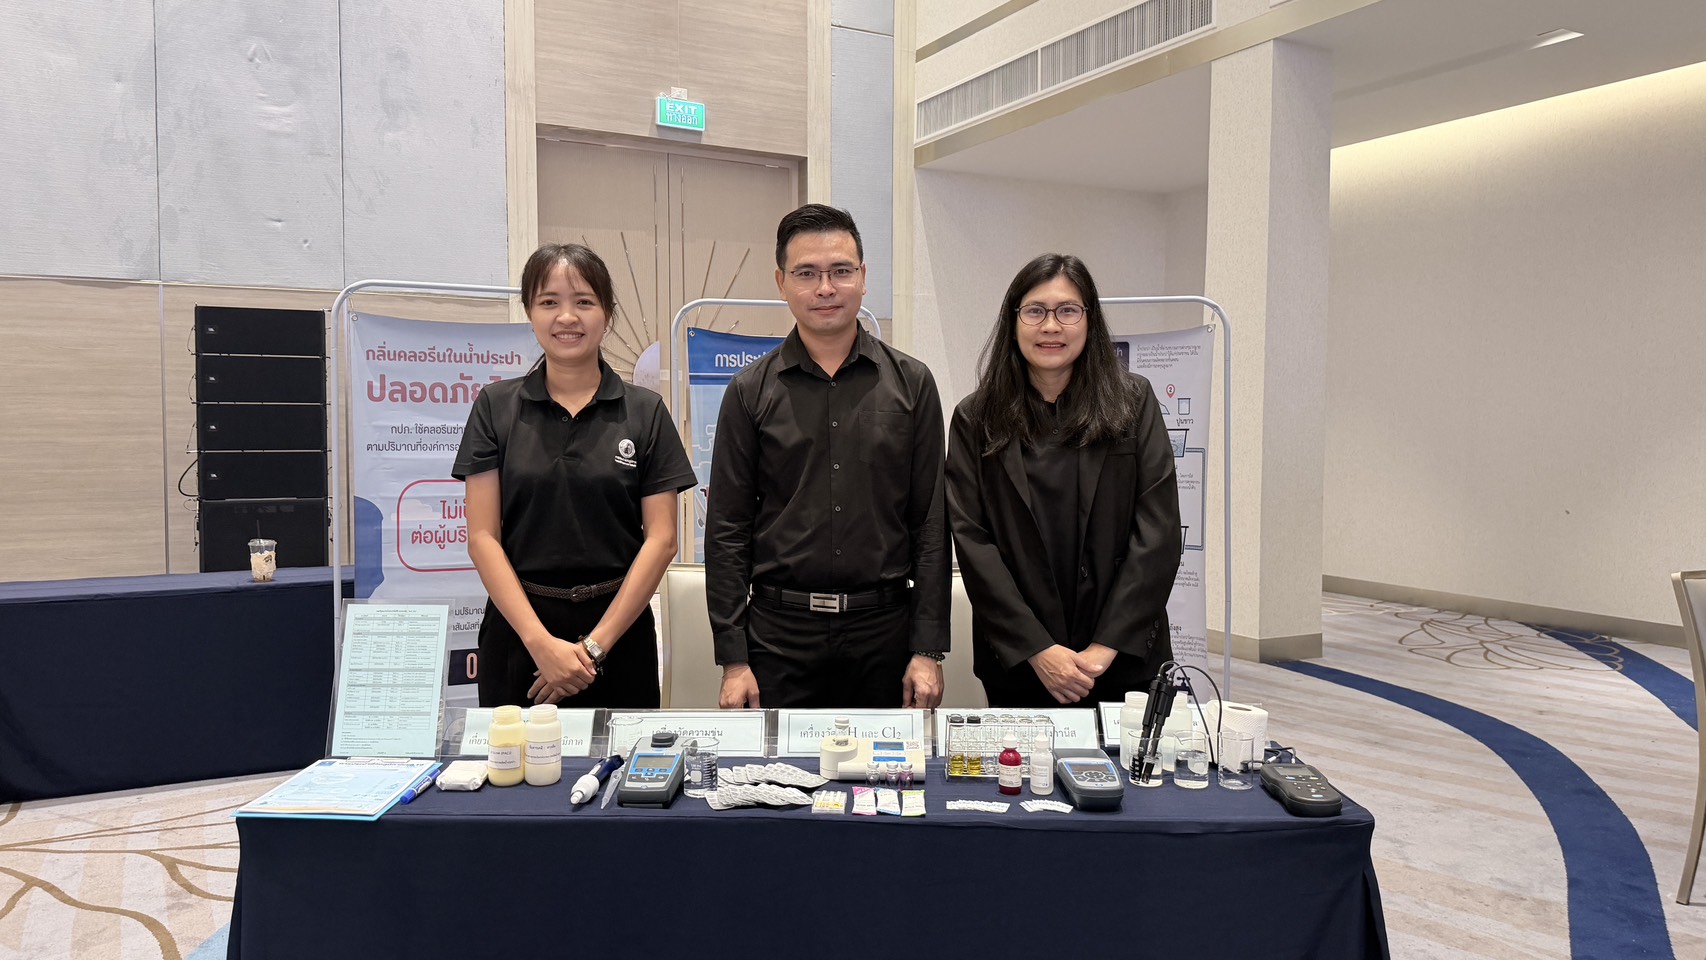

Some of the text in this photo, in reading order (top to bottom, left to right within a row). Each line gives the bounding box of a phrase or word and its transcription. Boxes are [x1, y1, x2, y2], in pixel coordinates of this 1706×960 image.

[666, 103, 698, 115] EXIT
[365, 341, 522, 366] กลิ่นคลอรีนในน้ำประปา
[366, 373, 502, 403] ปลอดภัย
[391, 423, 465, 435] กปภ. ใช้คลอรีนฆ่า
[861, 730, 879, 739] และ
